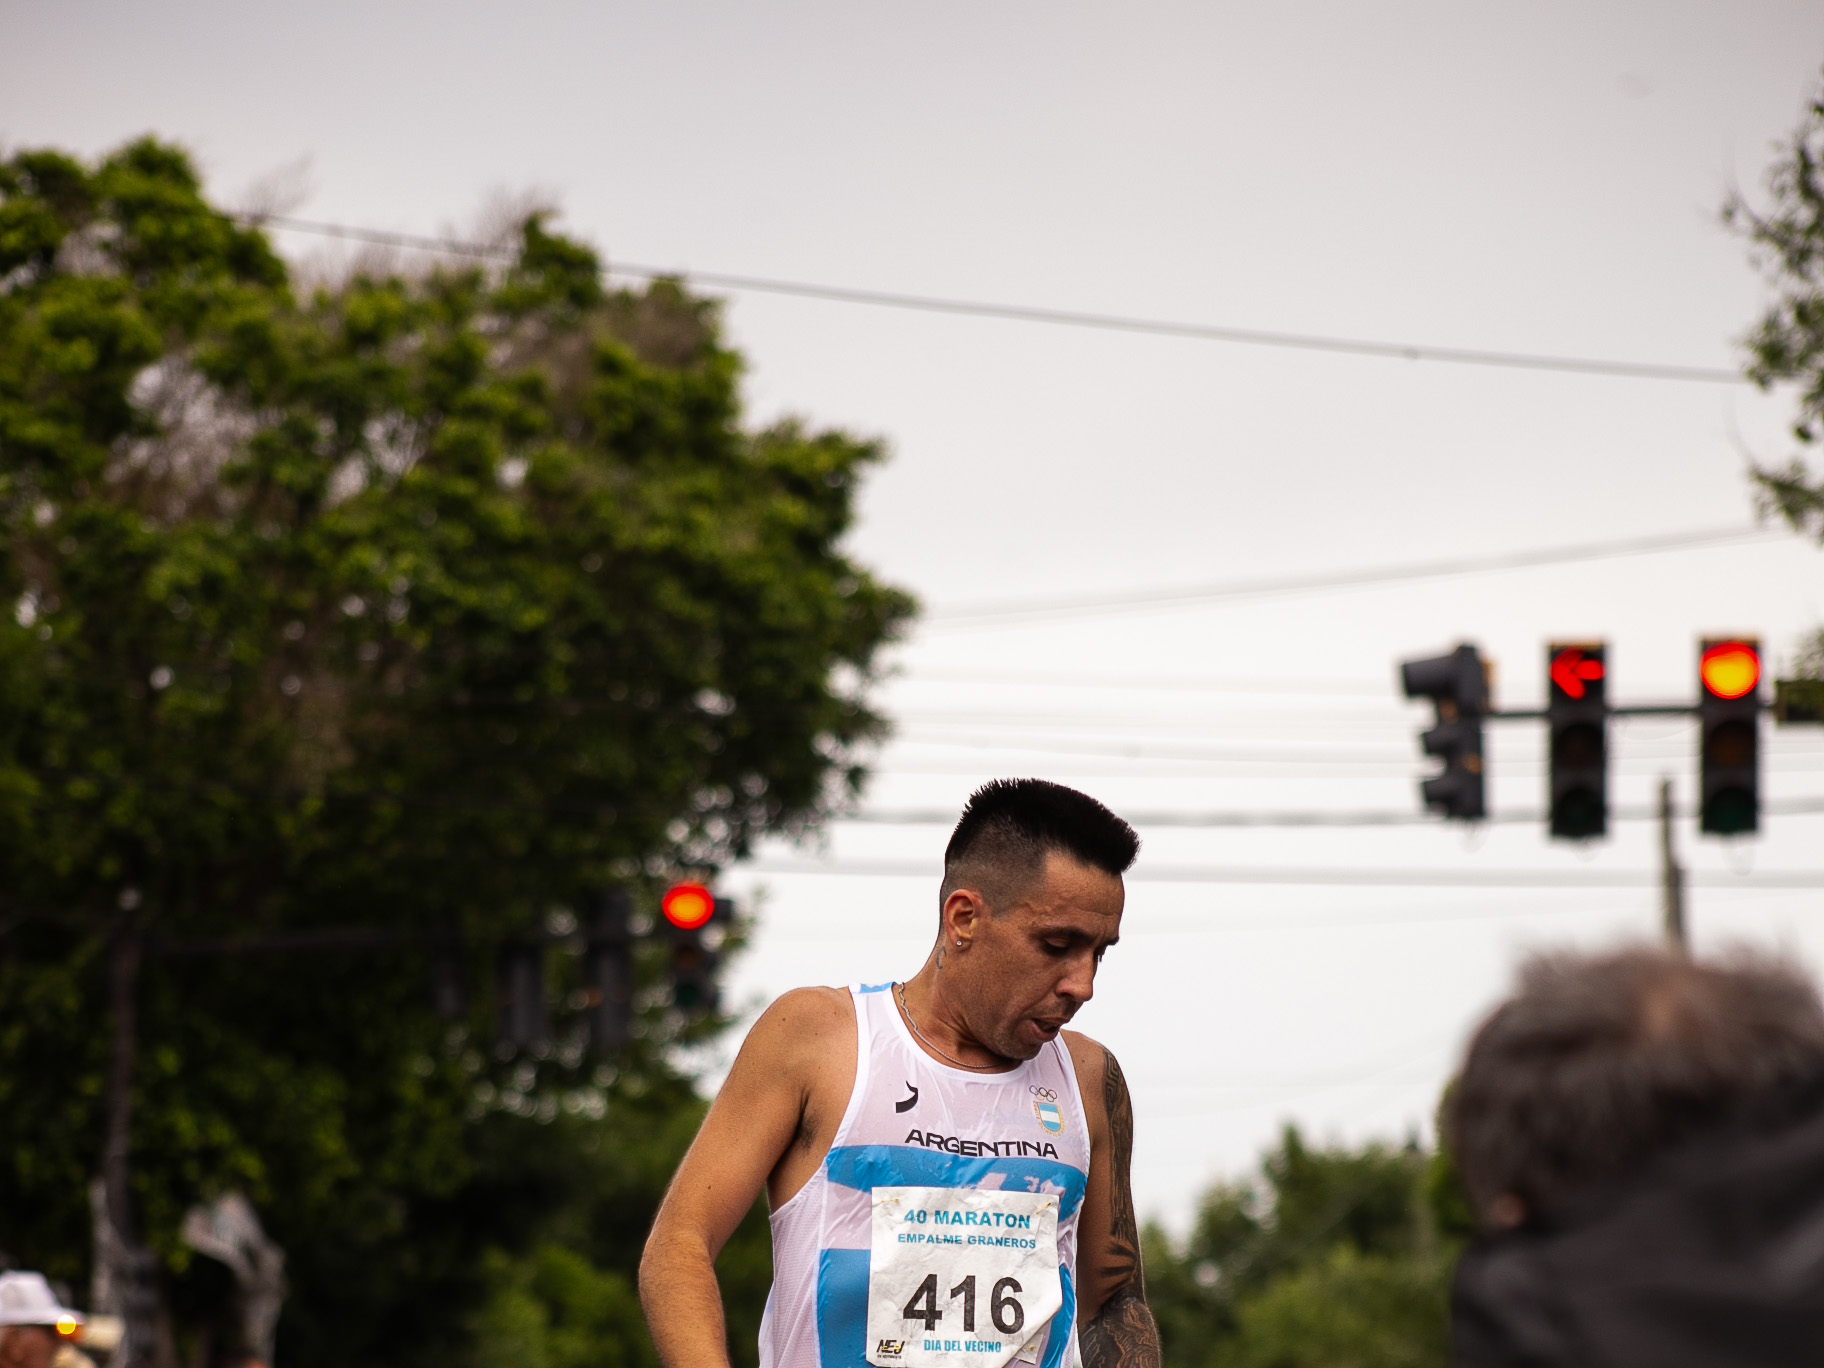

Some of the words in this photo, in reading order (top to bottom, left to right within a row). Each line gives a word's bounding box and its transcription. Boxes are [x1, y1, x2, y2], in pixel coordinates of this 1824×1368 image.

[905, 1129, 1058, 1160] ARGENTINA
[904, 1209, 928, 1225] 40
[934, 1210, 1030, 1229] MARATON
[898, 1233, 963, 1245] EMPALME
[967, 1235, 1036, 1249] GRANEROS
[903, 1273, 1025, 1335] 416
[924, 1339, 942, 1352] DIA
[944, 1340, 962, 1352] DEL
[964, 1340, 1002, 1353] VECINO
